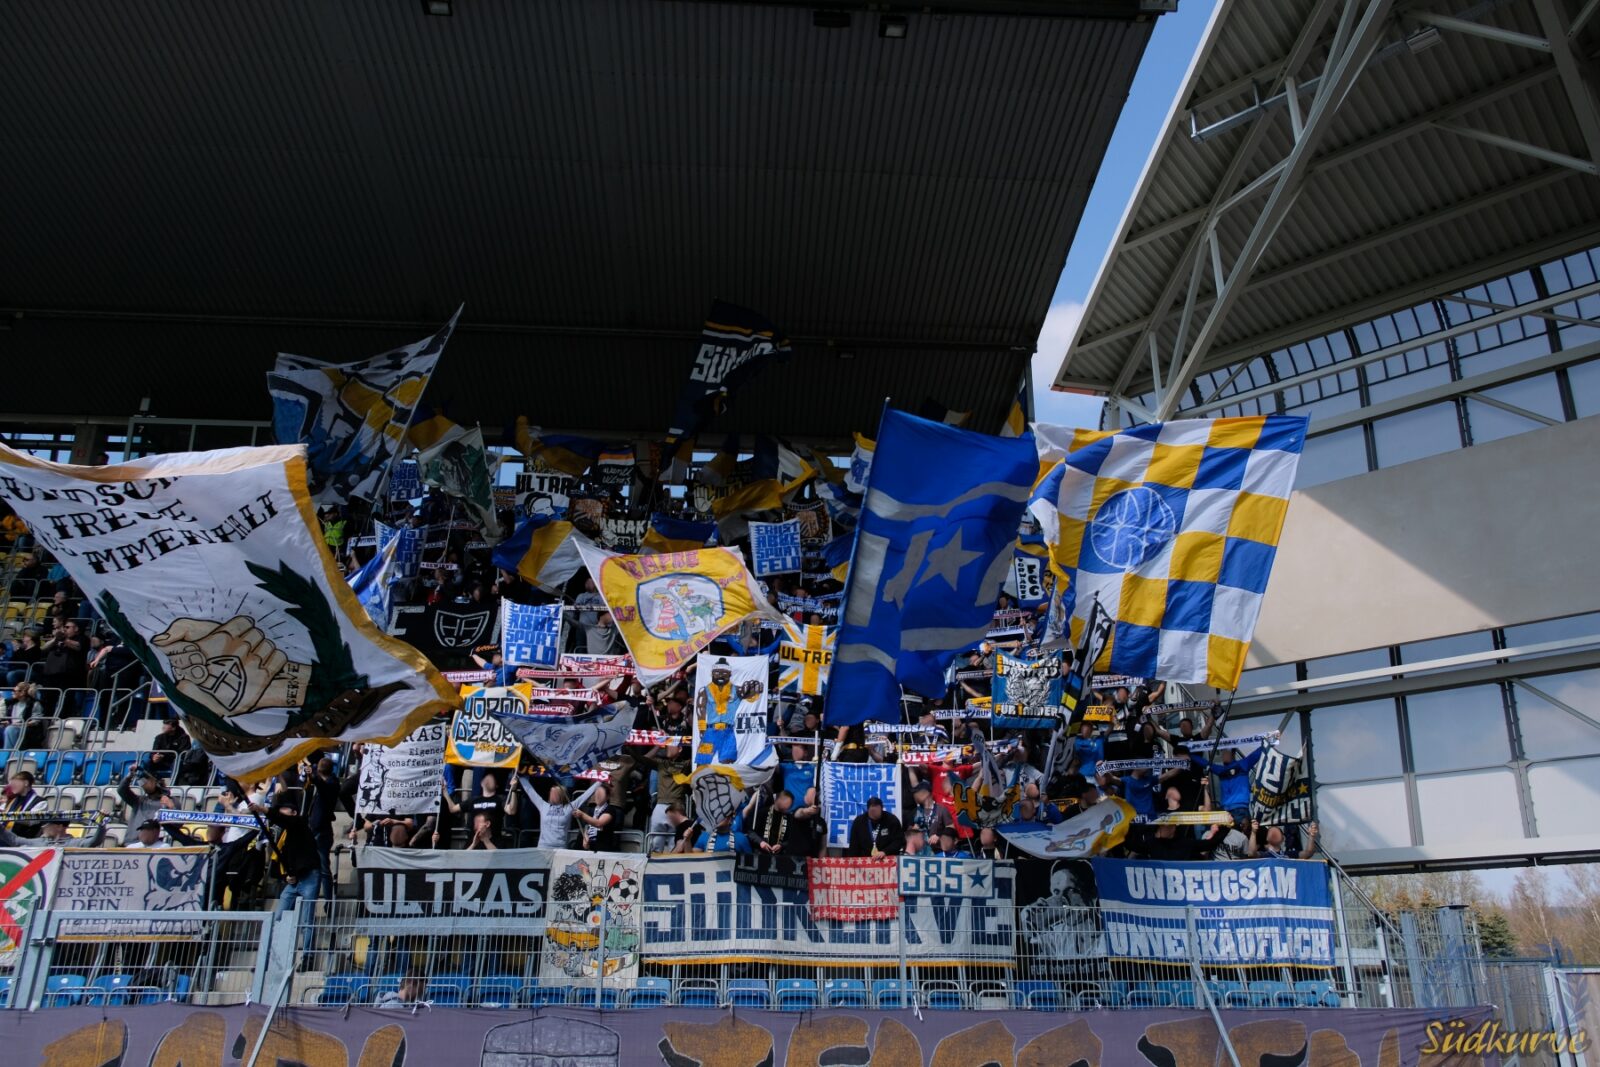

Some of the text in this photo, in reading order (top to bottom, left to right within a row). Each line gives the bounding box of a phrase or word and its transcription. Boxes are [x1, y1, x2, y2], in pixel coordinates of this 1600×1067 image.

[757, 557, 800, 574] FELD
[510, 613, 559, 632] ABBE
[506, 629, 557, 644] SPORT
[506, 643, 557, 665] FELD
[830, 764, 896, 781] ERNST
[830, 782, 896, 802] ABBE
[61, 859, 140, 870] NUTZE DAS
[72, 872, 126, 886] SPIEL
[813, 866, 899, 885] SCHICKERIA
[903, 858, 964, 893] 385
[1125, 867, 1297, 900] UNBEUGSAM
[57, 886, 134, 898] ES KÖNNTE
[363, 872, 545, 914] ULTRAS
[813, 885, 899, 906] MÜNCHEN
[1200, 908, 1225, 918] UND
